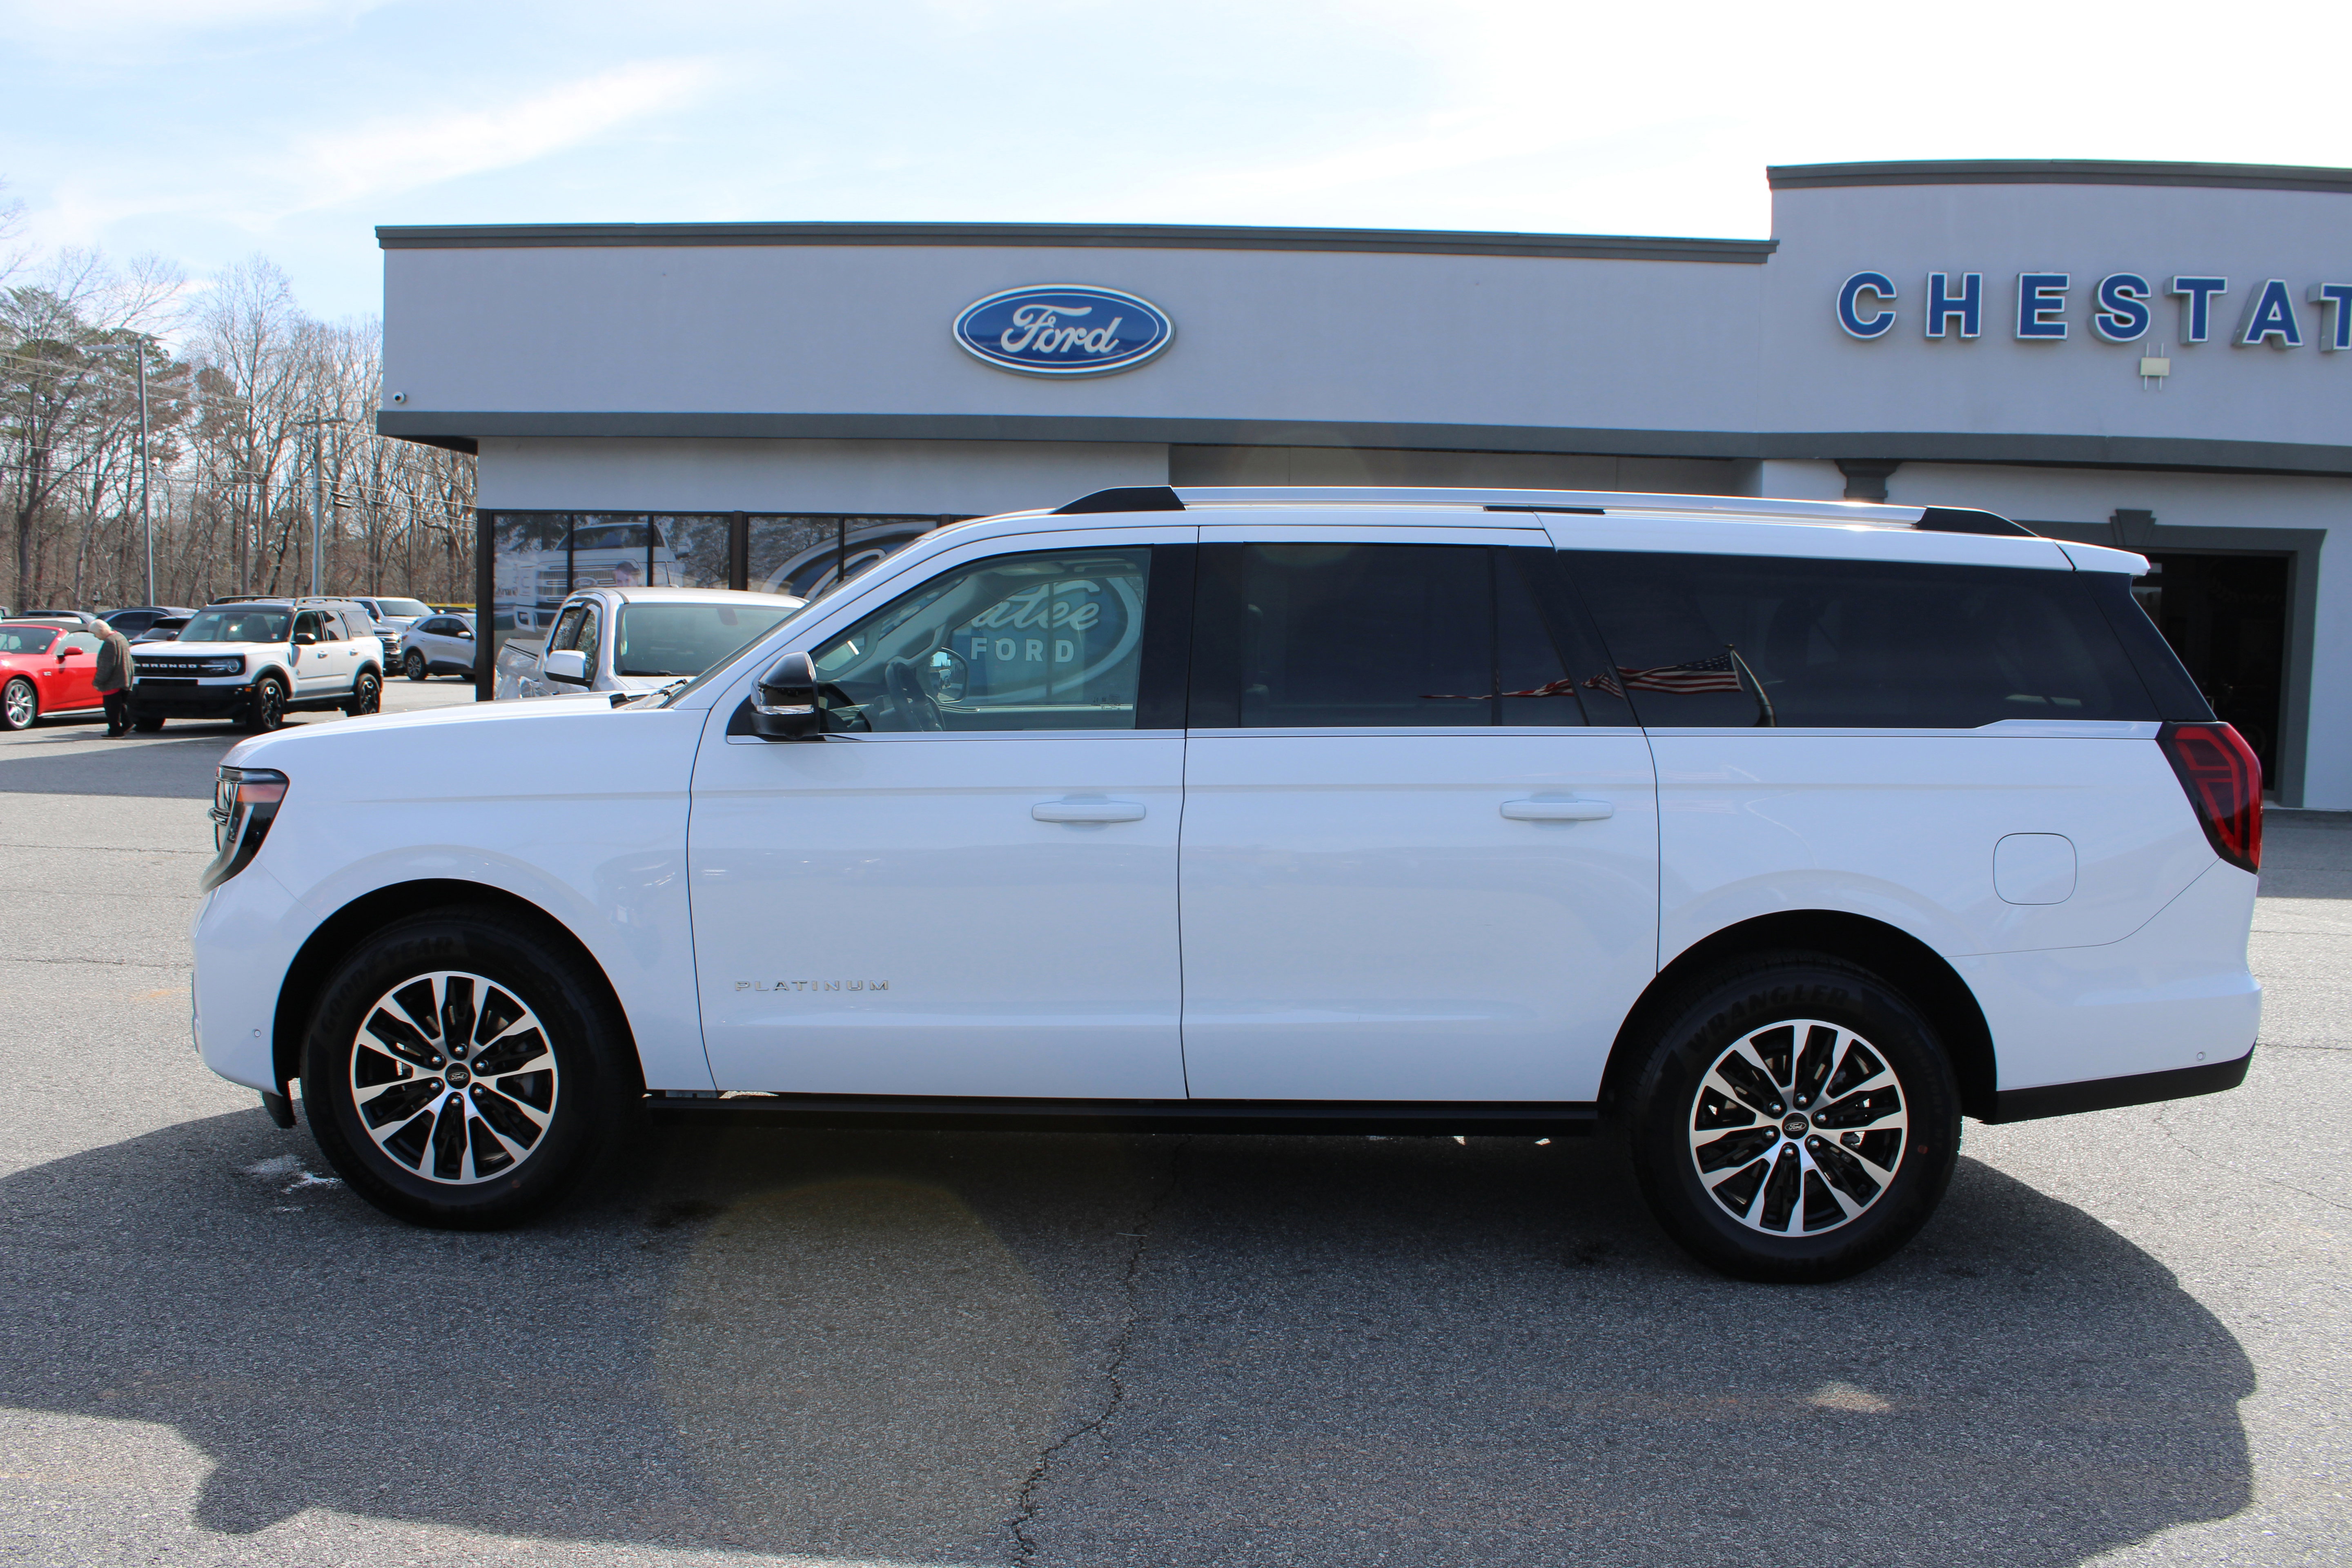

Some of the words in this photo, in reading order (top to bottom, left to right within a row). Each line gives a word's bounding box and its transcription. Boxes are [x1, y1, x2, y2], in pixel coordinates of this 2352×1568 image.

[1000, 304, 1123, 353] Ford
[971, 637, 1074, 662] FORD
[735, 980, 889, 991] PLATINUM
[1686, 984, 1849, 1054] WRANGLER
